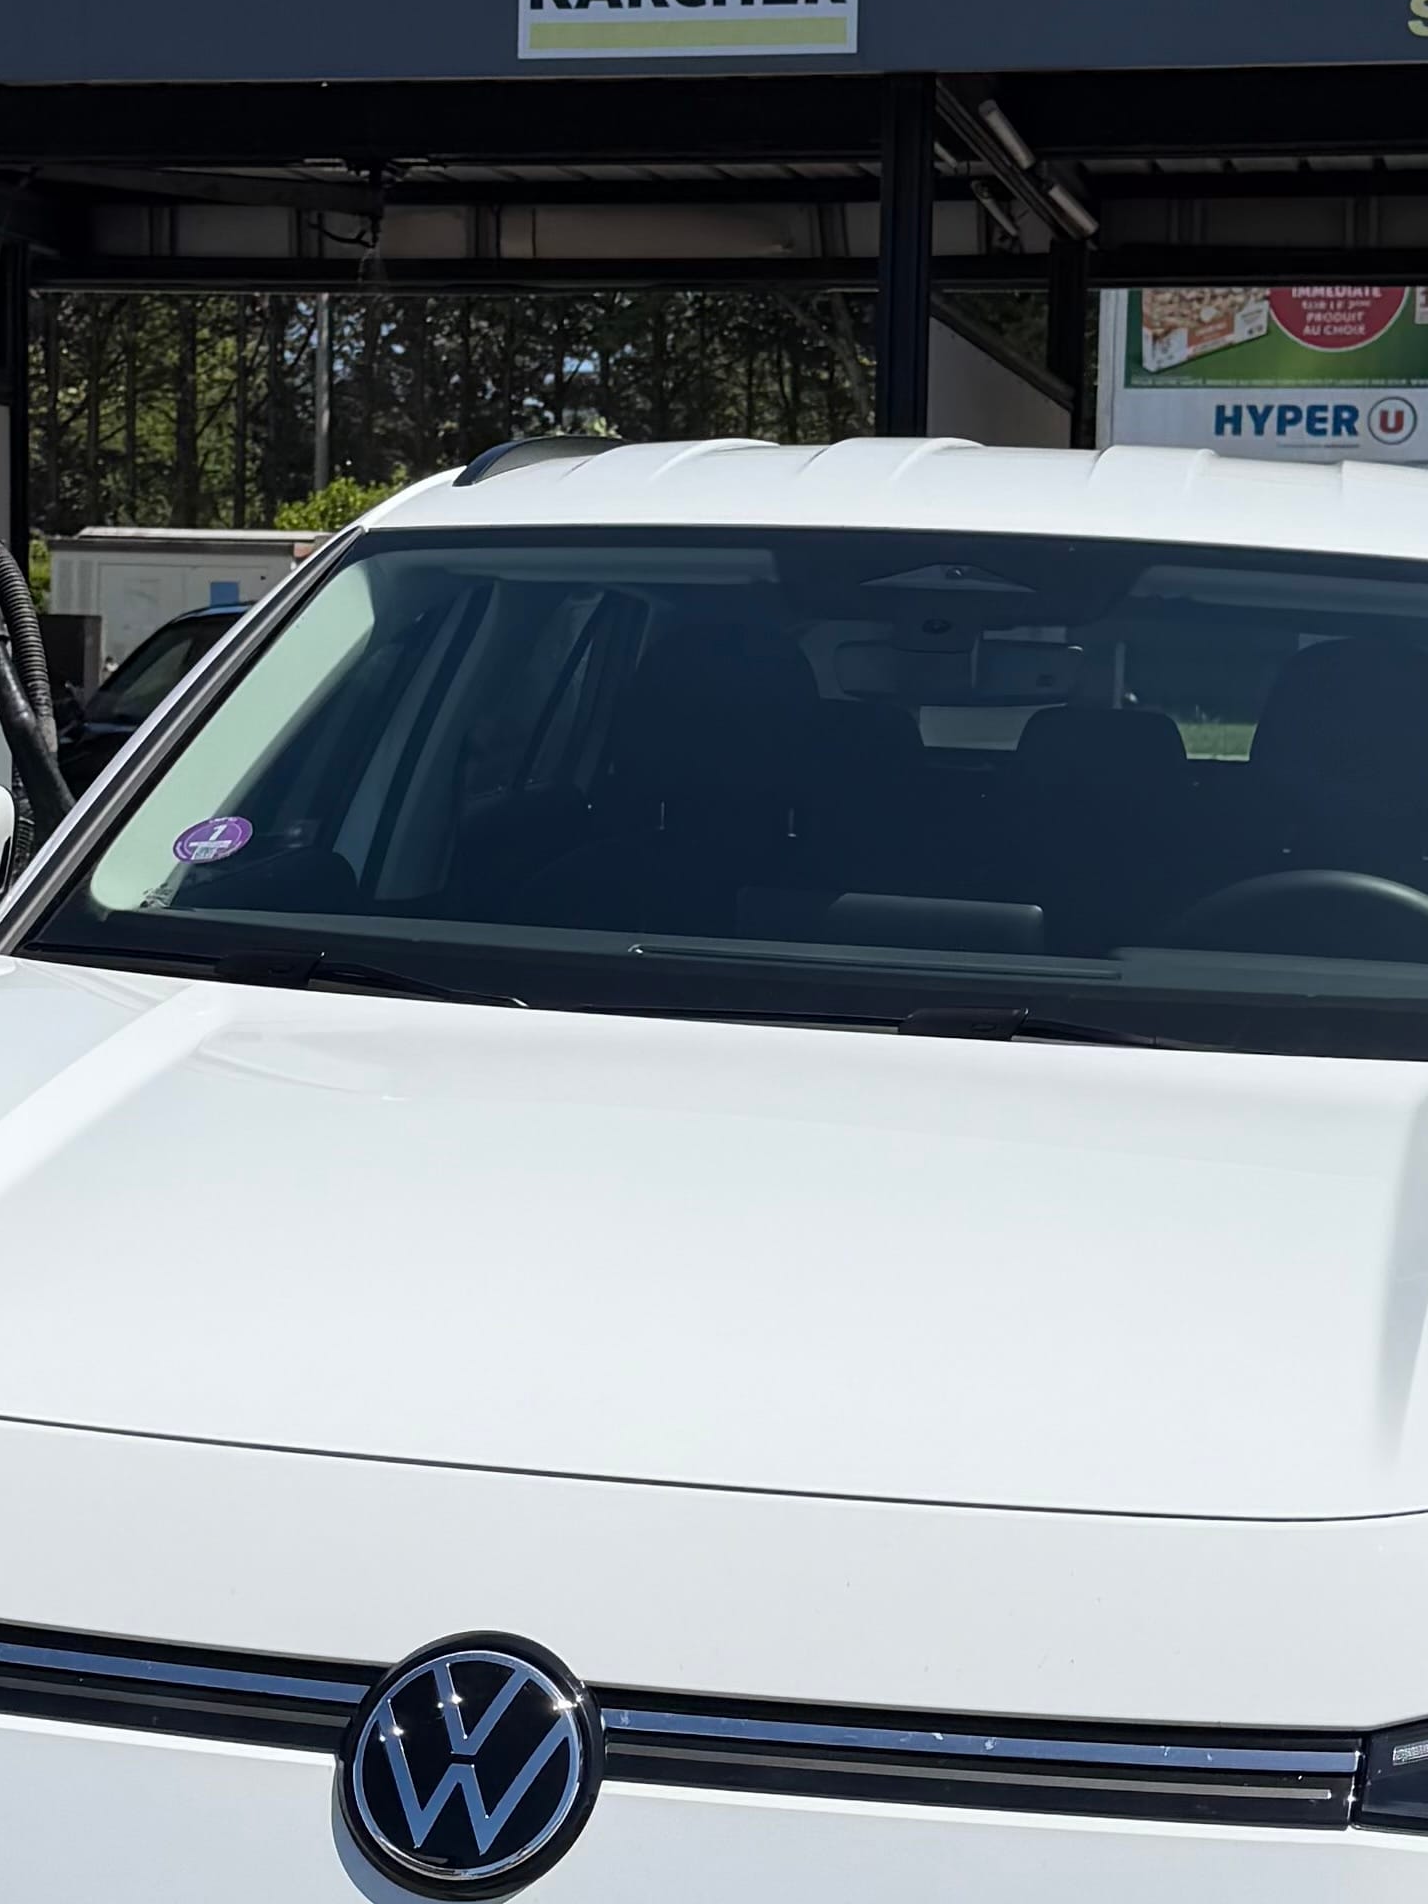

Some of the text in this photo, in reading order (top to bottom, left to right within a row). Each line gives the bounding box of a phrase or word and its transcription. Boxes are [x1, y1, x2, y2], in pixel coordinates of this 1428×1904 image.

[1305, 311, 1366, 323] PRODUIT
[1302, 325, 1322, 336] AU
[1213, 404, 1360, 437] HYPER
[208, 824, 228, 841] 1
